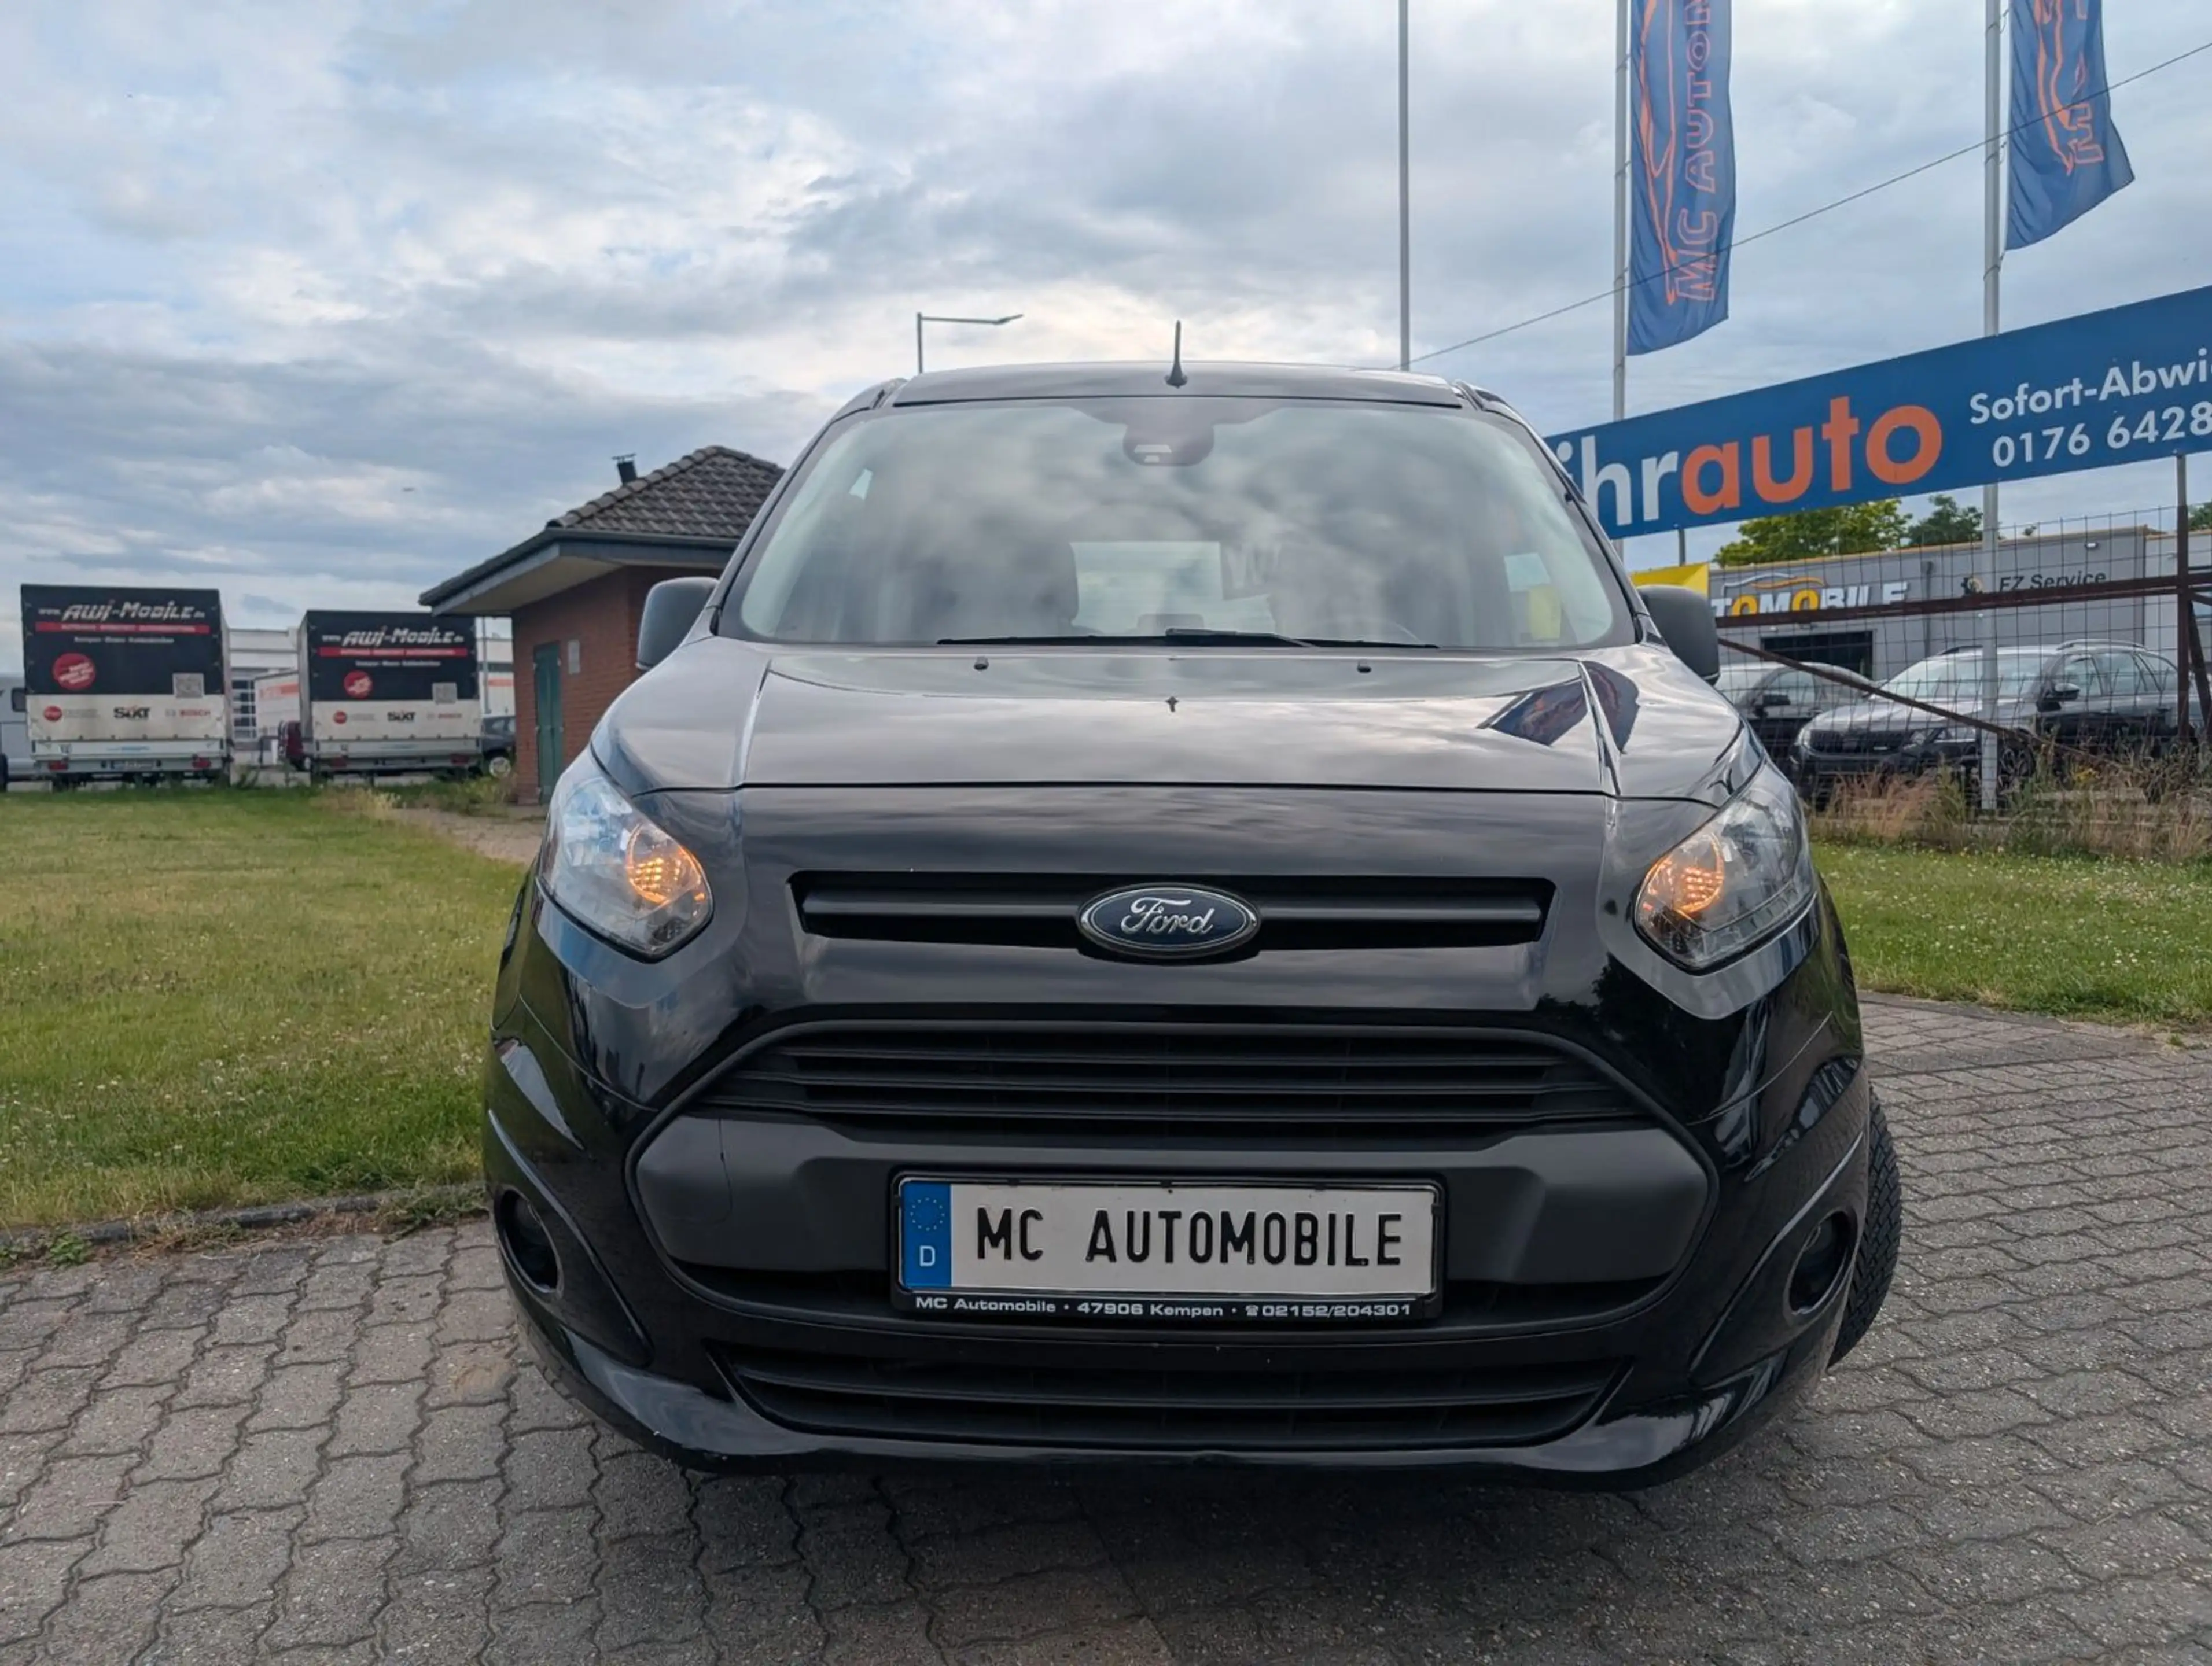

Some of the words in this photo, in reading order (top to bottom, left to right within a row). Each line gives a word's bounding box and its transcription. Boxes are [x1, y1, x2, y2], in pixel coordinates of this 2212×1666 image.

[1674, 207, 1719, 302] MC
[1970, 348, 2212, 425] Sofort-Abwi
[1992, 423, 2090, 467] 0176
[2107, 401, 2212, 449] 6428
[2029, 570, 2107, 590] Service
[1120, 897, 1214, 934] Ford
[919, 1245, 936, 1267] D
[977, 1207, 1044, 1261] MC
[1085, 1209, 1402, 1266] AUTOMOBILE
[915, 1296, 948, 1309] MC
[954, 1298, 1056, 1313] Automobile
[1077, 1302, 1144, 1315] 47906
